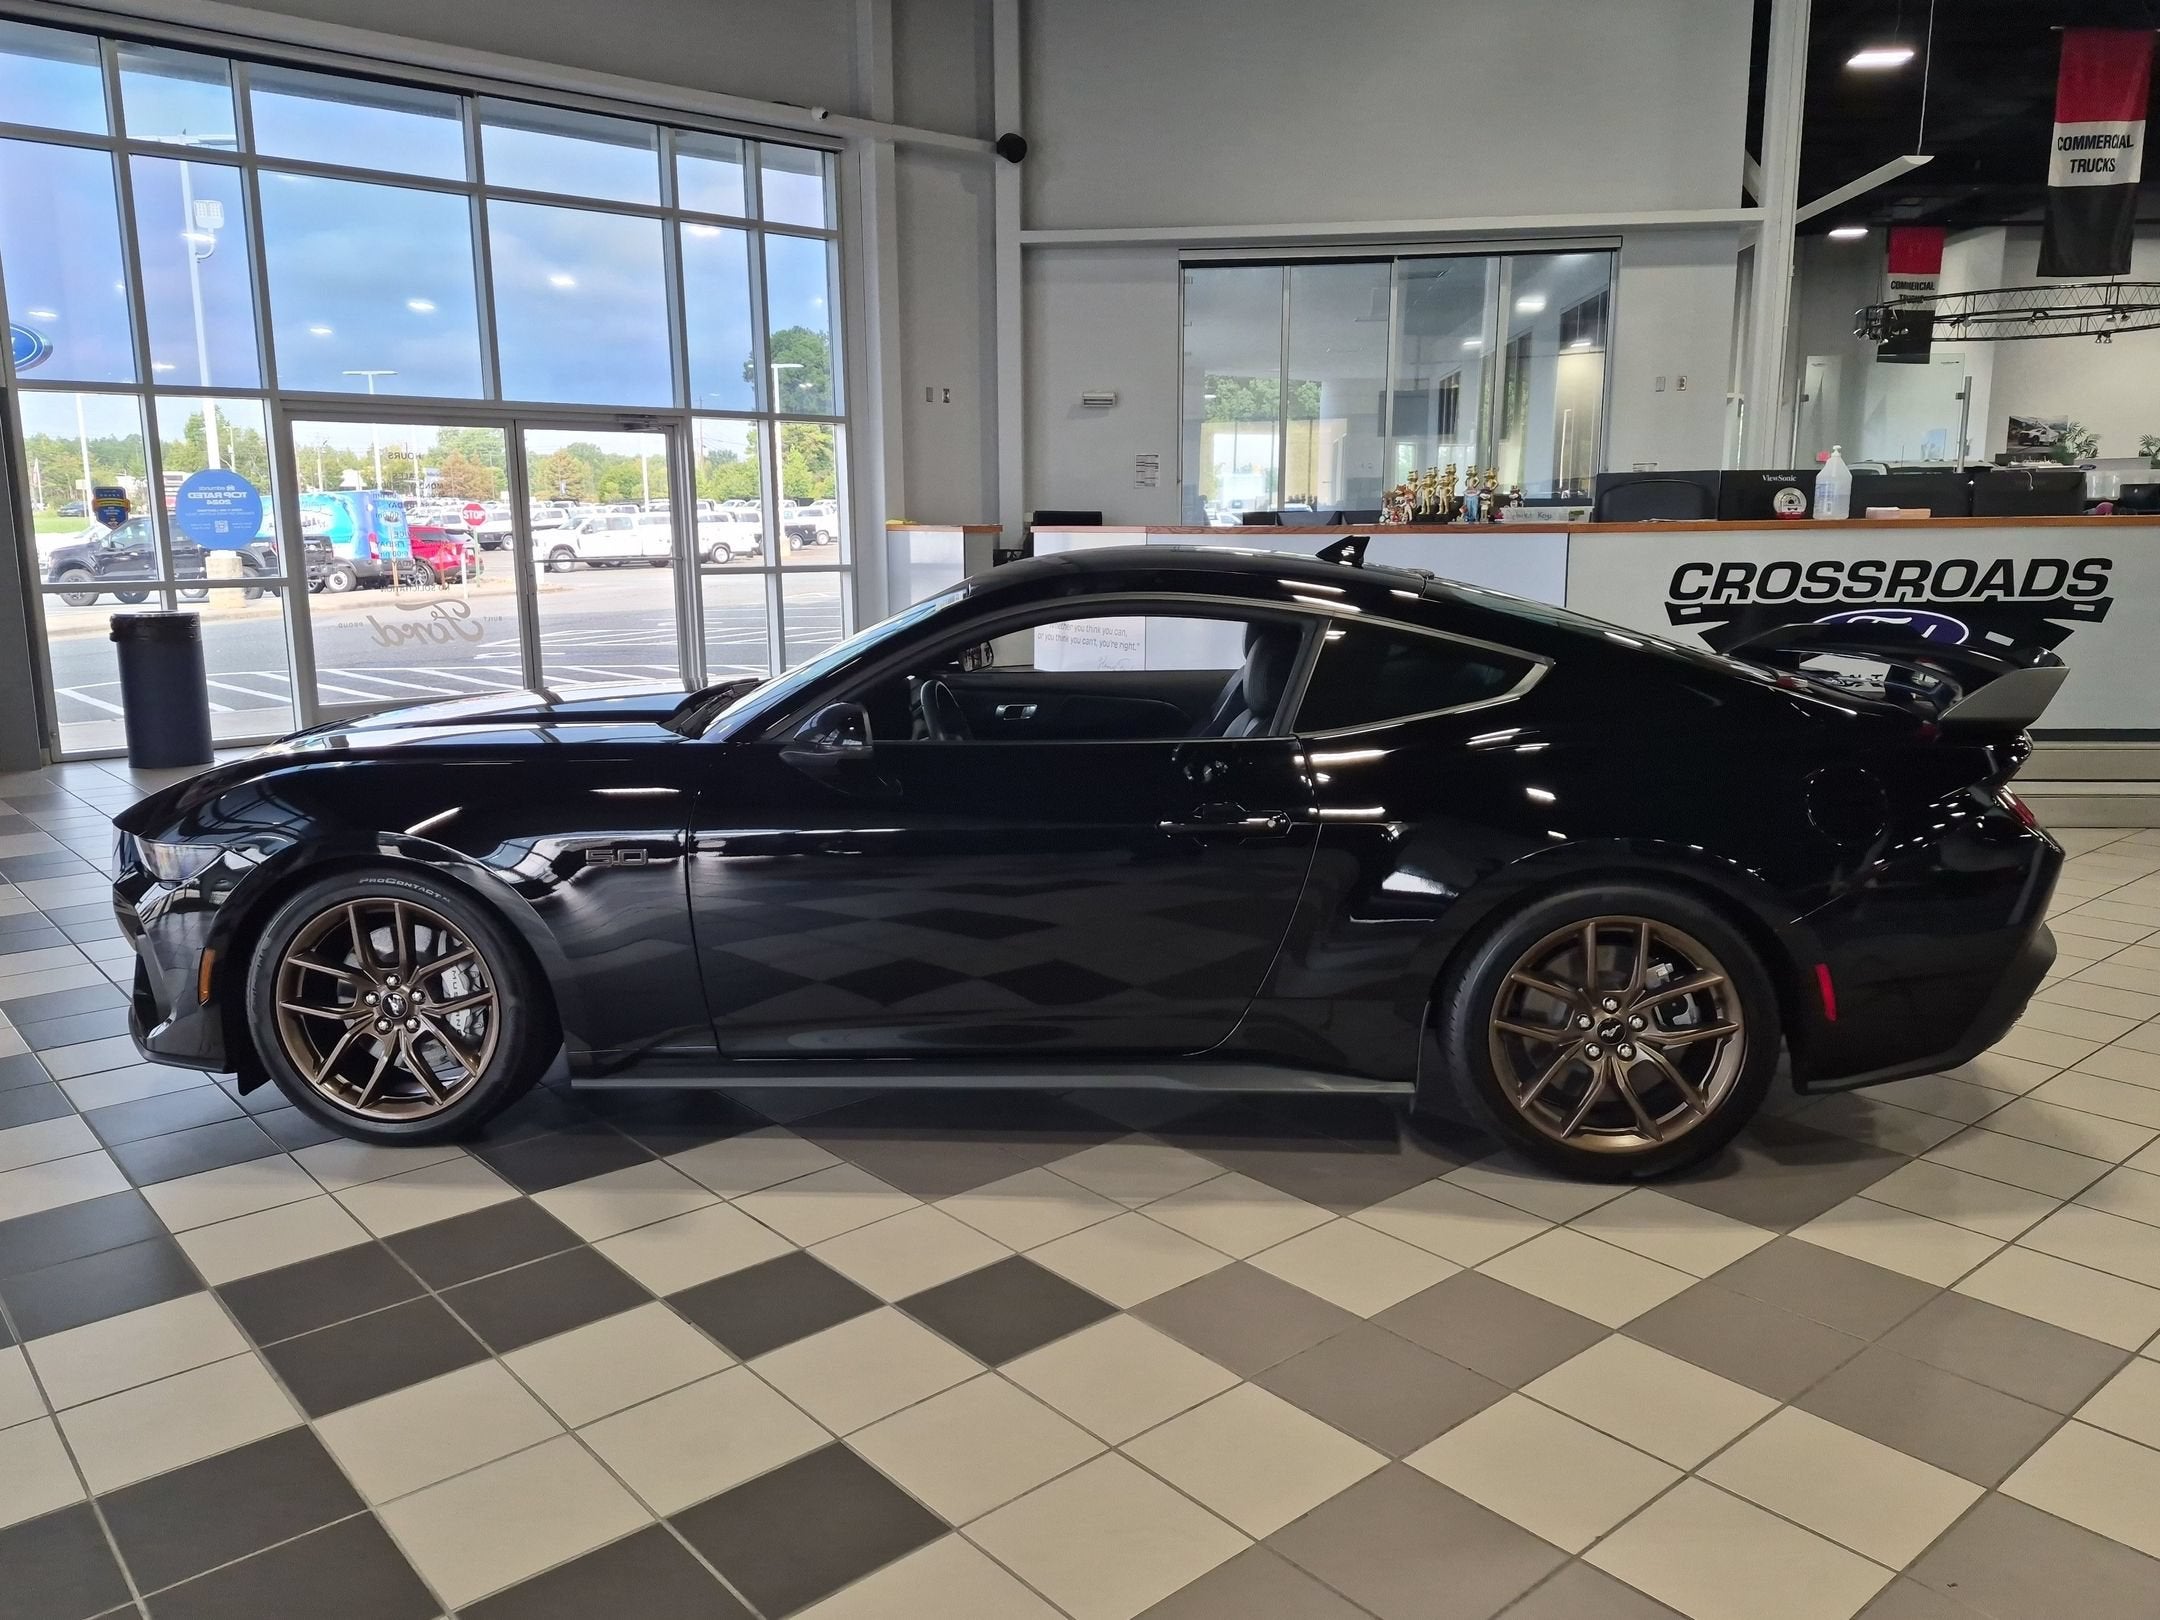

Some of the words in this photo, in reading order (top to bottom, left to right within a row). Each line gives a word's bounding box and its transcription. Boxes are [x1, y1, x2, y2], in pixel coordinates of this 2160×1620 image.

[2057, 134, 2134, 152] COMMERCIAL
[2070, 157, 2116, 174] TRUCKS
[1890, 280, 1936, 291] COMMERCIAL
[1762, 474, 1797, 482] ViewSonic
[463, 509, 484, 519] STOP
[1668, 558, 2113, 601] CROSSROADS
[1102, 627, 1114, 636] you
[1070, 637, 1081, 645] you
